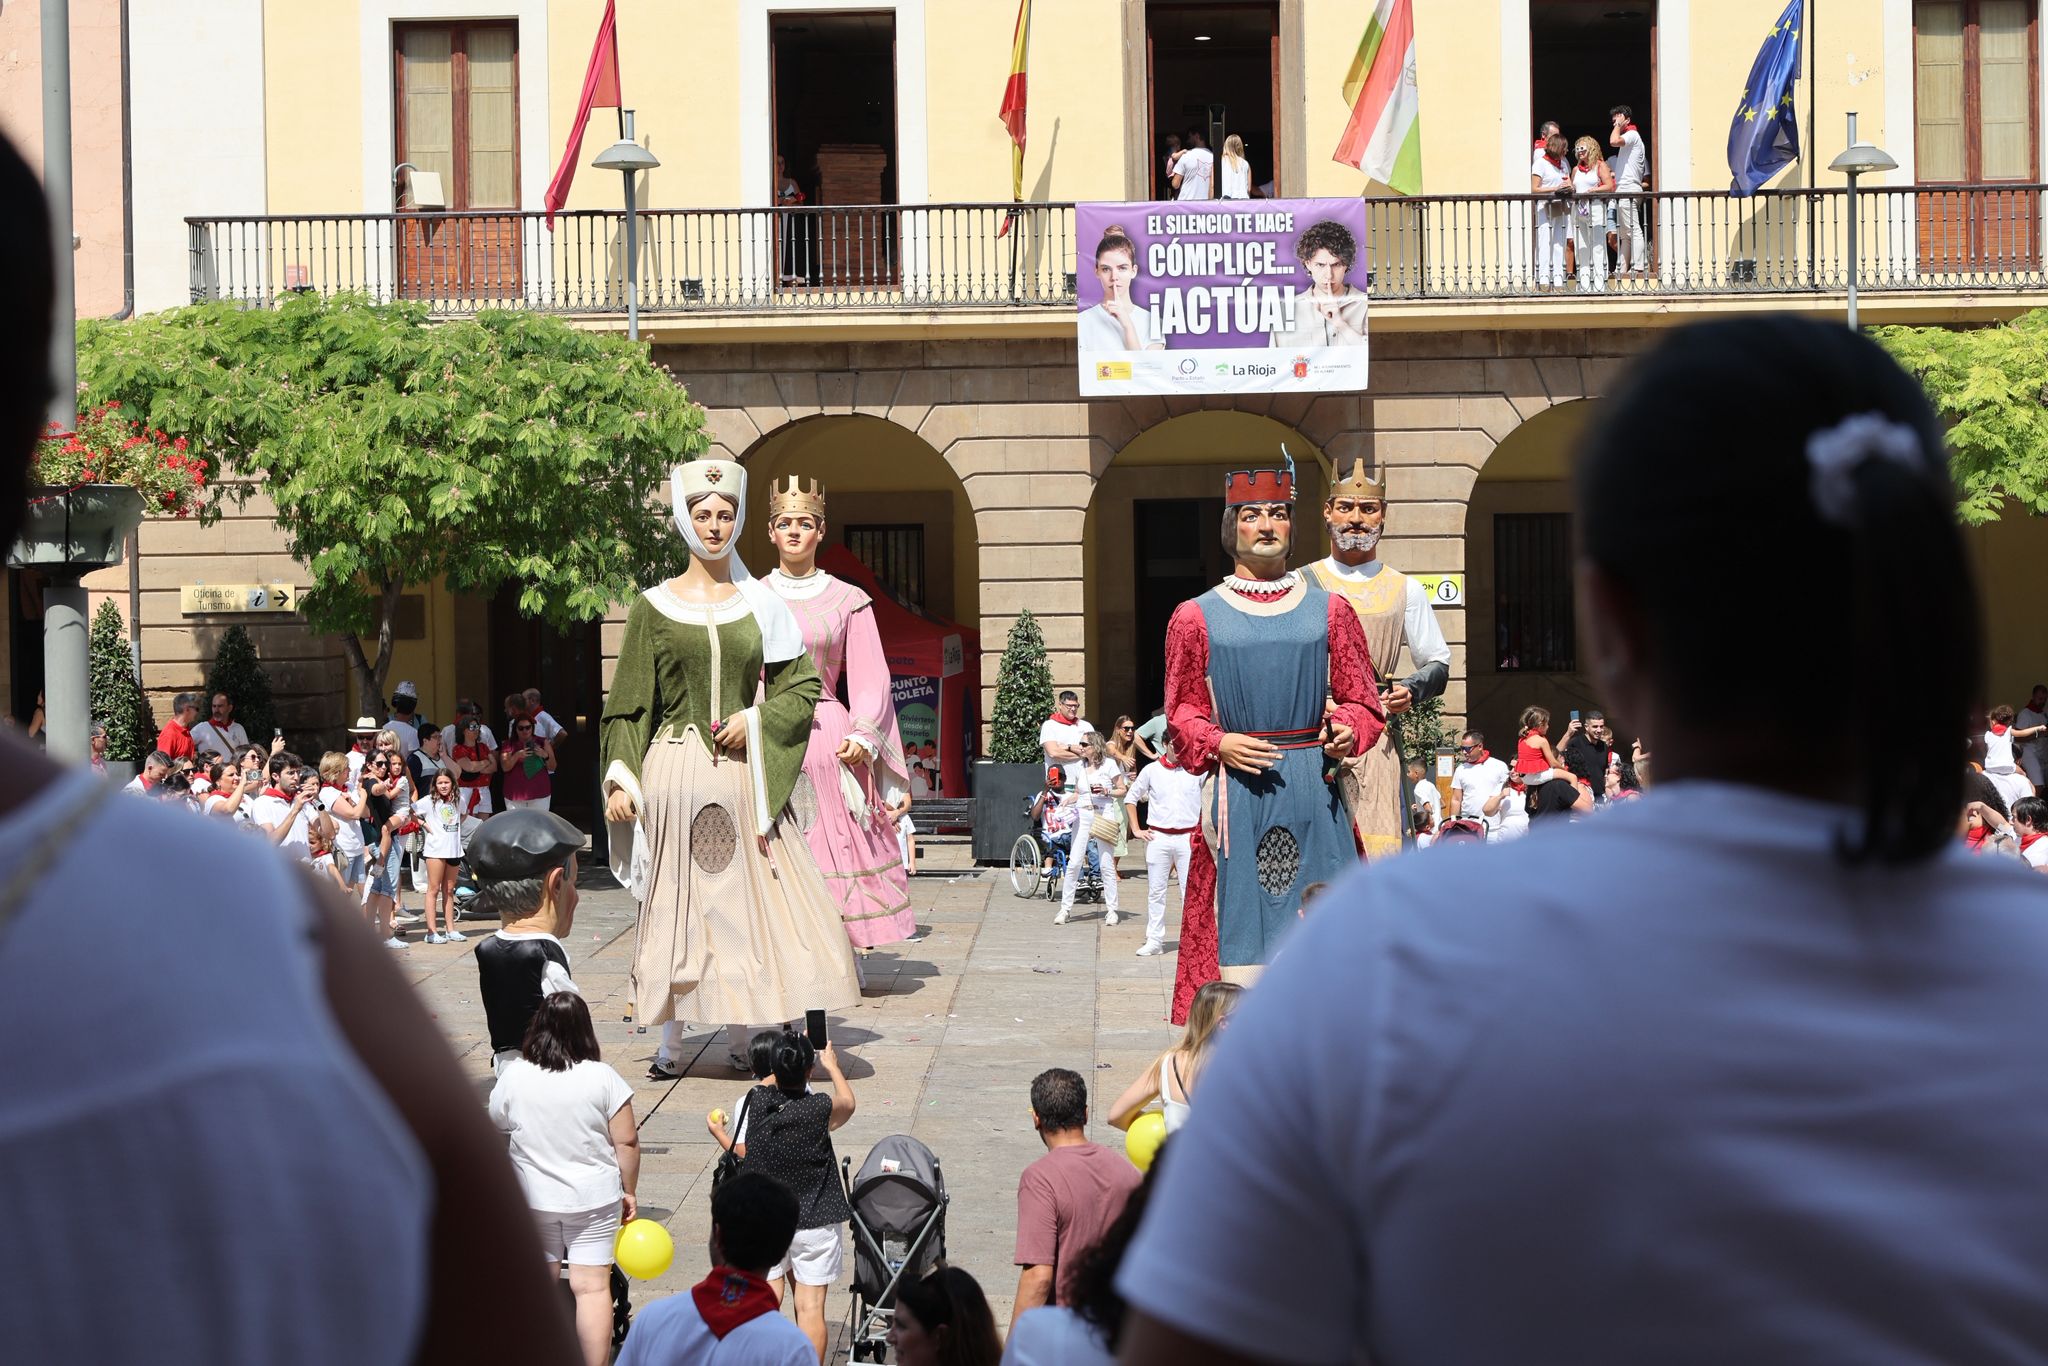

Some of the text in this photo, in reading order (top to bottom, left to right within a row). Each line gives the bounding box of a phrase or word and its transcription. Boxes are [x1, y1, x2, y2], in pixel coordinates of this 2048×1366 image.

[1148, 212, 1294, 235] EL SILENCIO TE HACE
[1148, 238, 1295, 278] CÓMPLICE...
[1150, 278, 1297, 340] ¡ACTÚA!
[1233, 364, 1277, 377] La Rioja
[193, 589, 222, 599] Oficina
[224, 589, 235, 598] de
[198, 600, 231, 610] Turismo
[890, 676, 928, 691] PUNTO
[903, 721, 923, 730] desde
